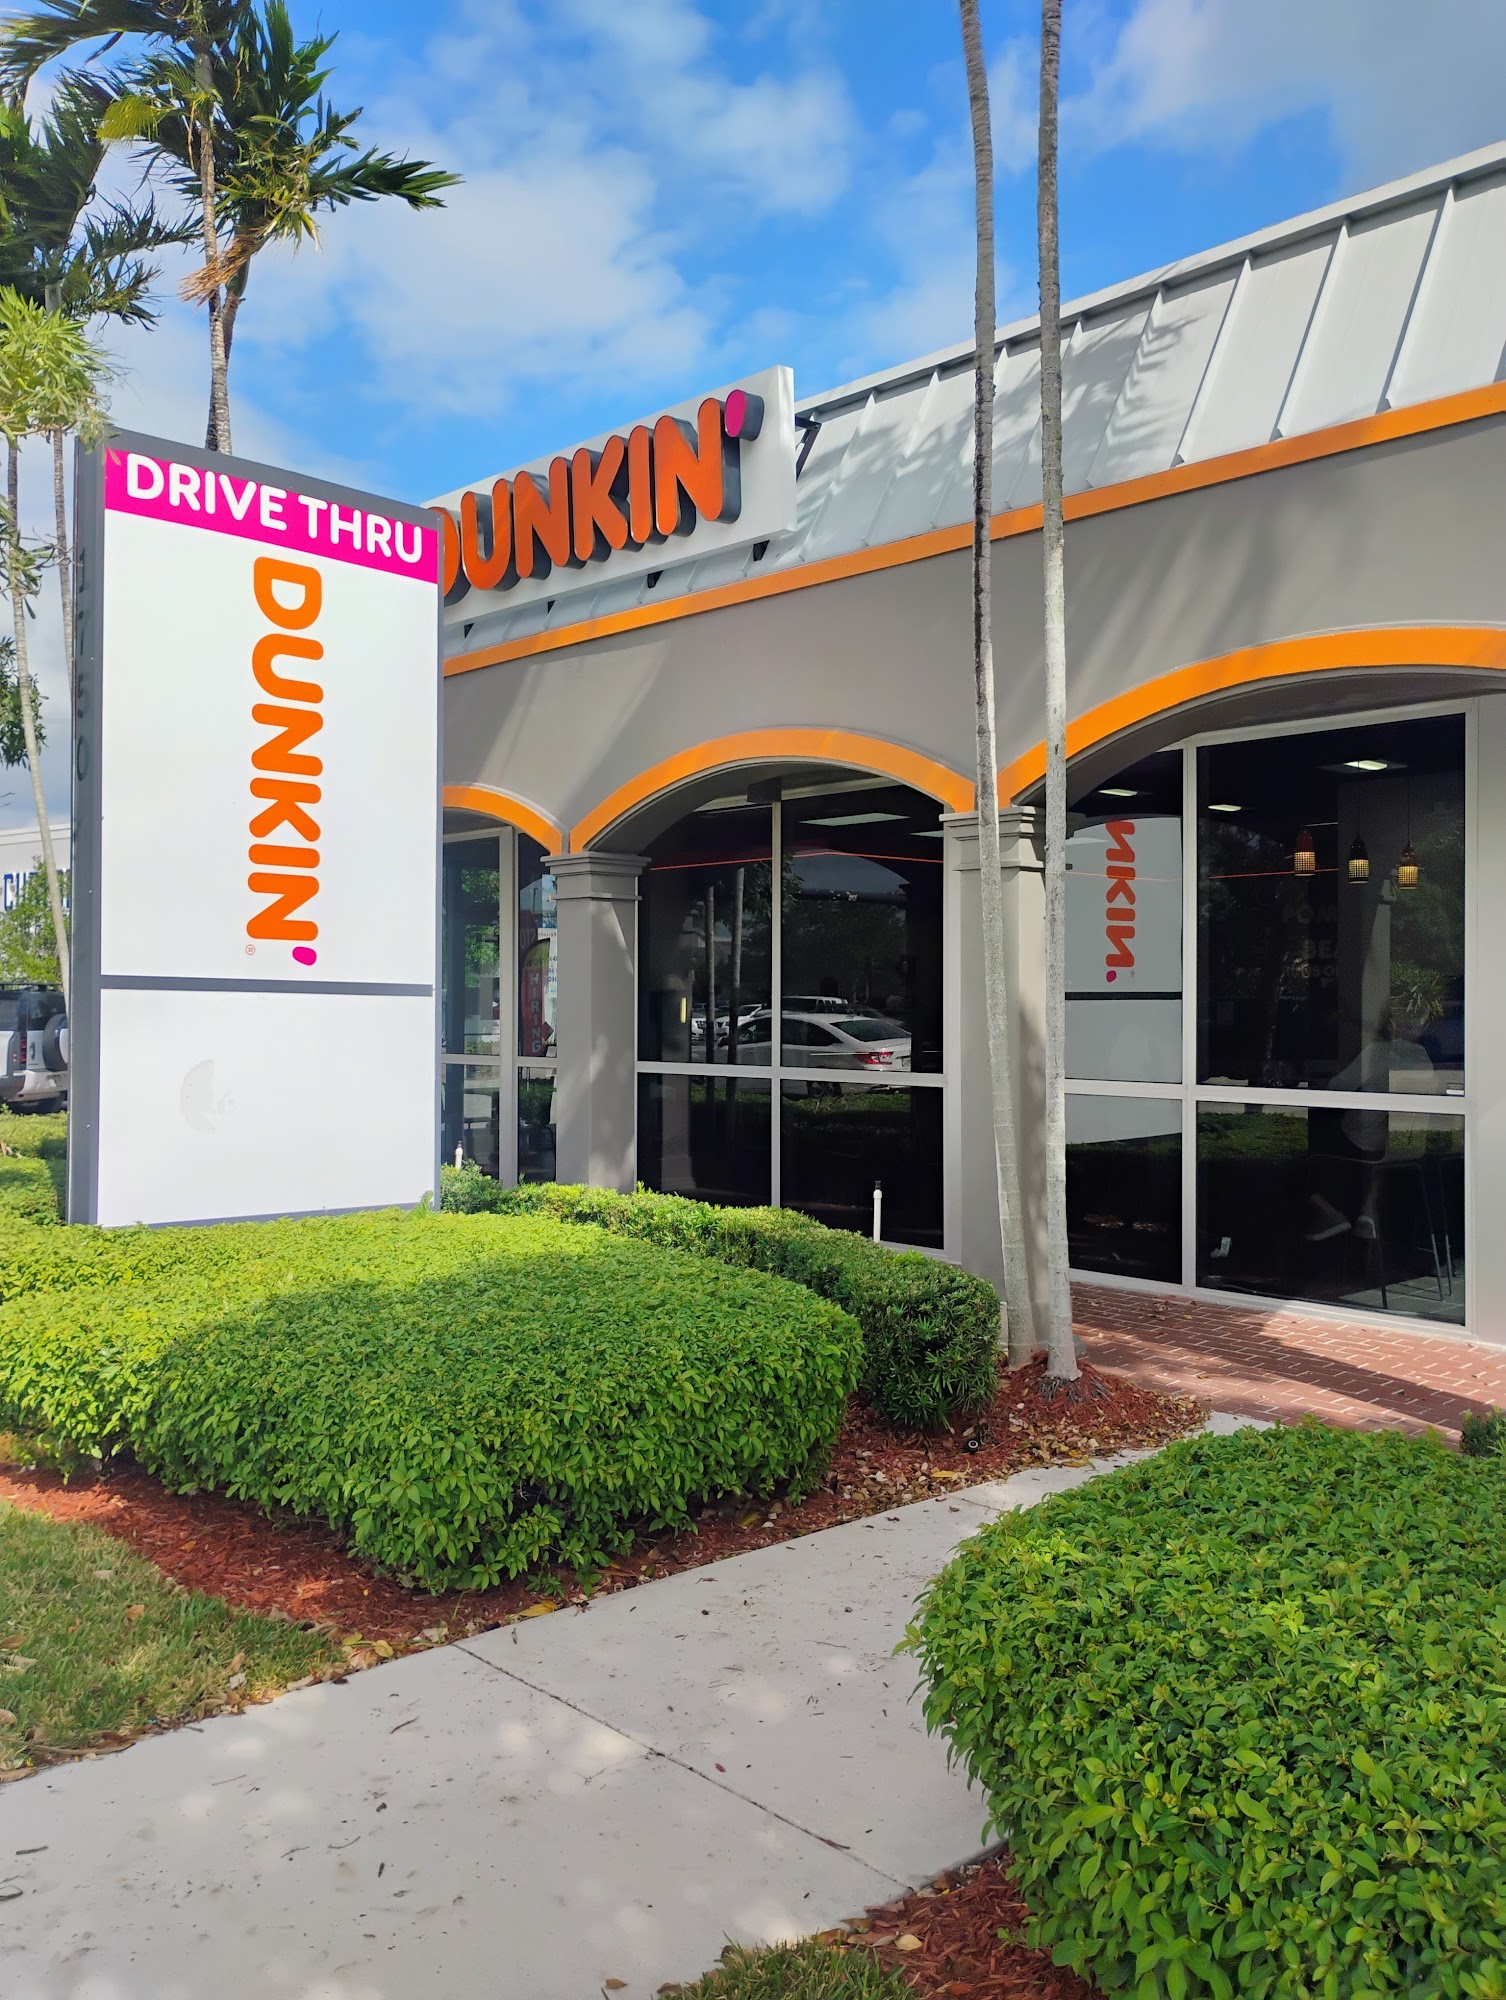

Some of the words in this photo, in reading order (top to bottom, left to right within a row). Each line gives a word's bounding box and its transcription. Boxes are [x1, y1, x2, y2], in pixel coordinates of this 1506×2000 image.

[126, 452, 288, 531] DRIVE
[298, 494, 423, 564] THRU
[246, 557, 324, 966] DUNKIN'
[529, 972, 542, 1053] HIRING
